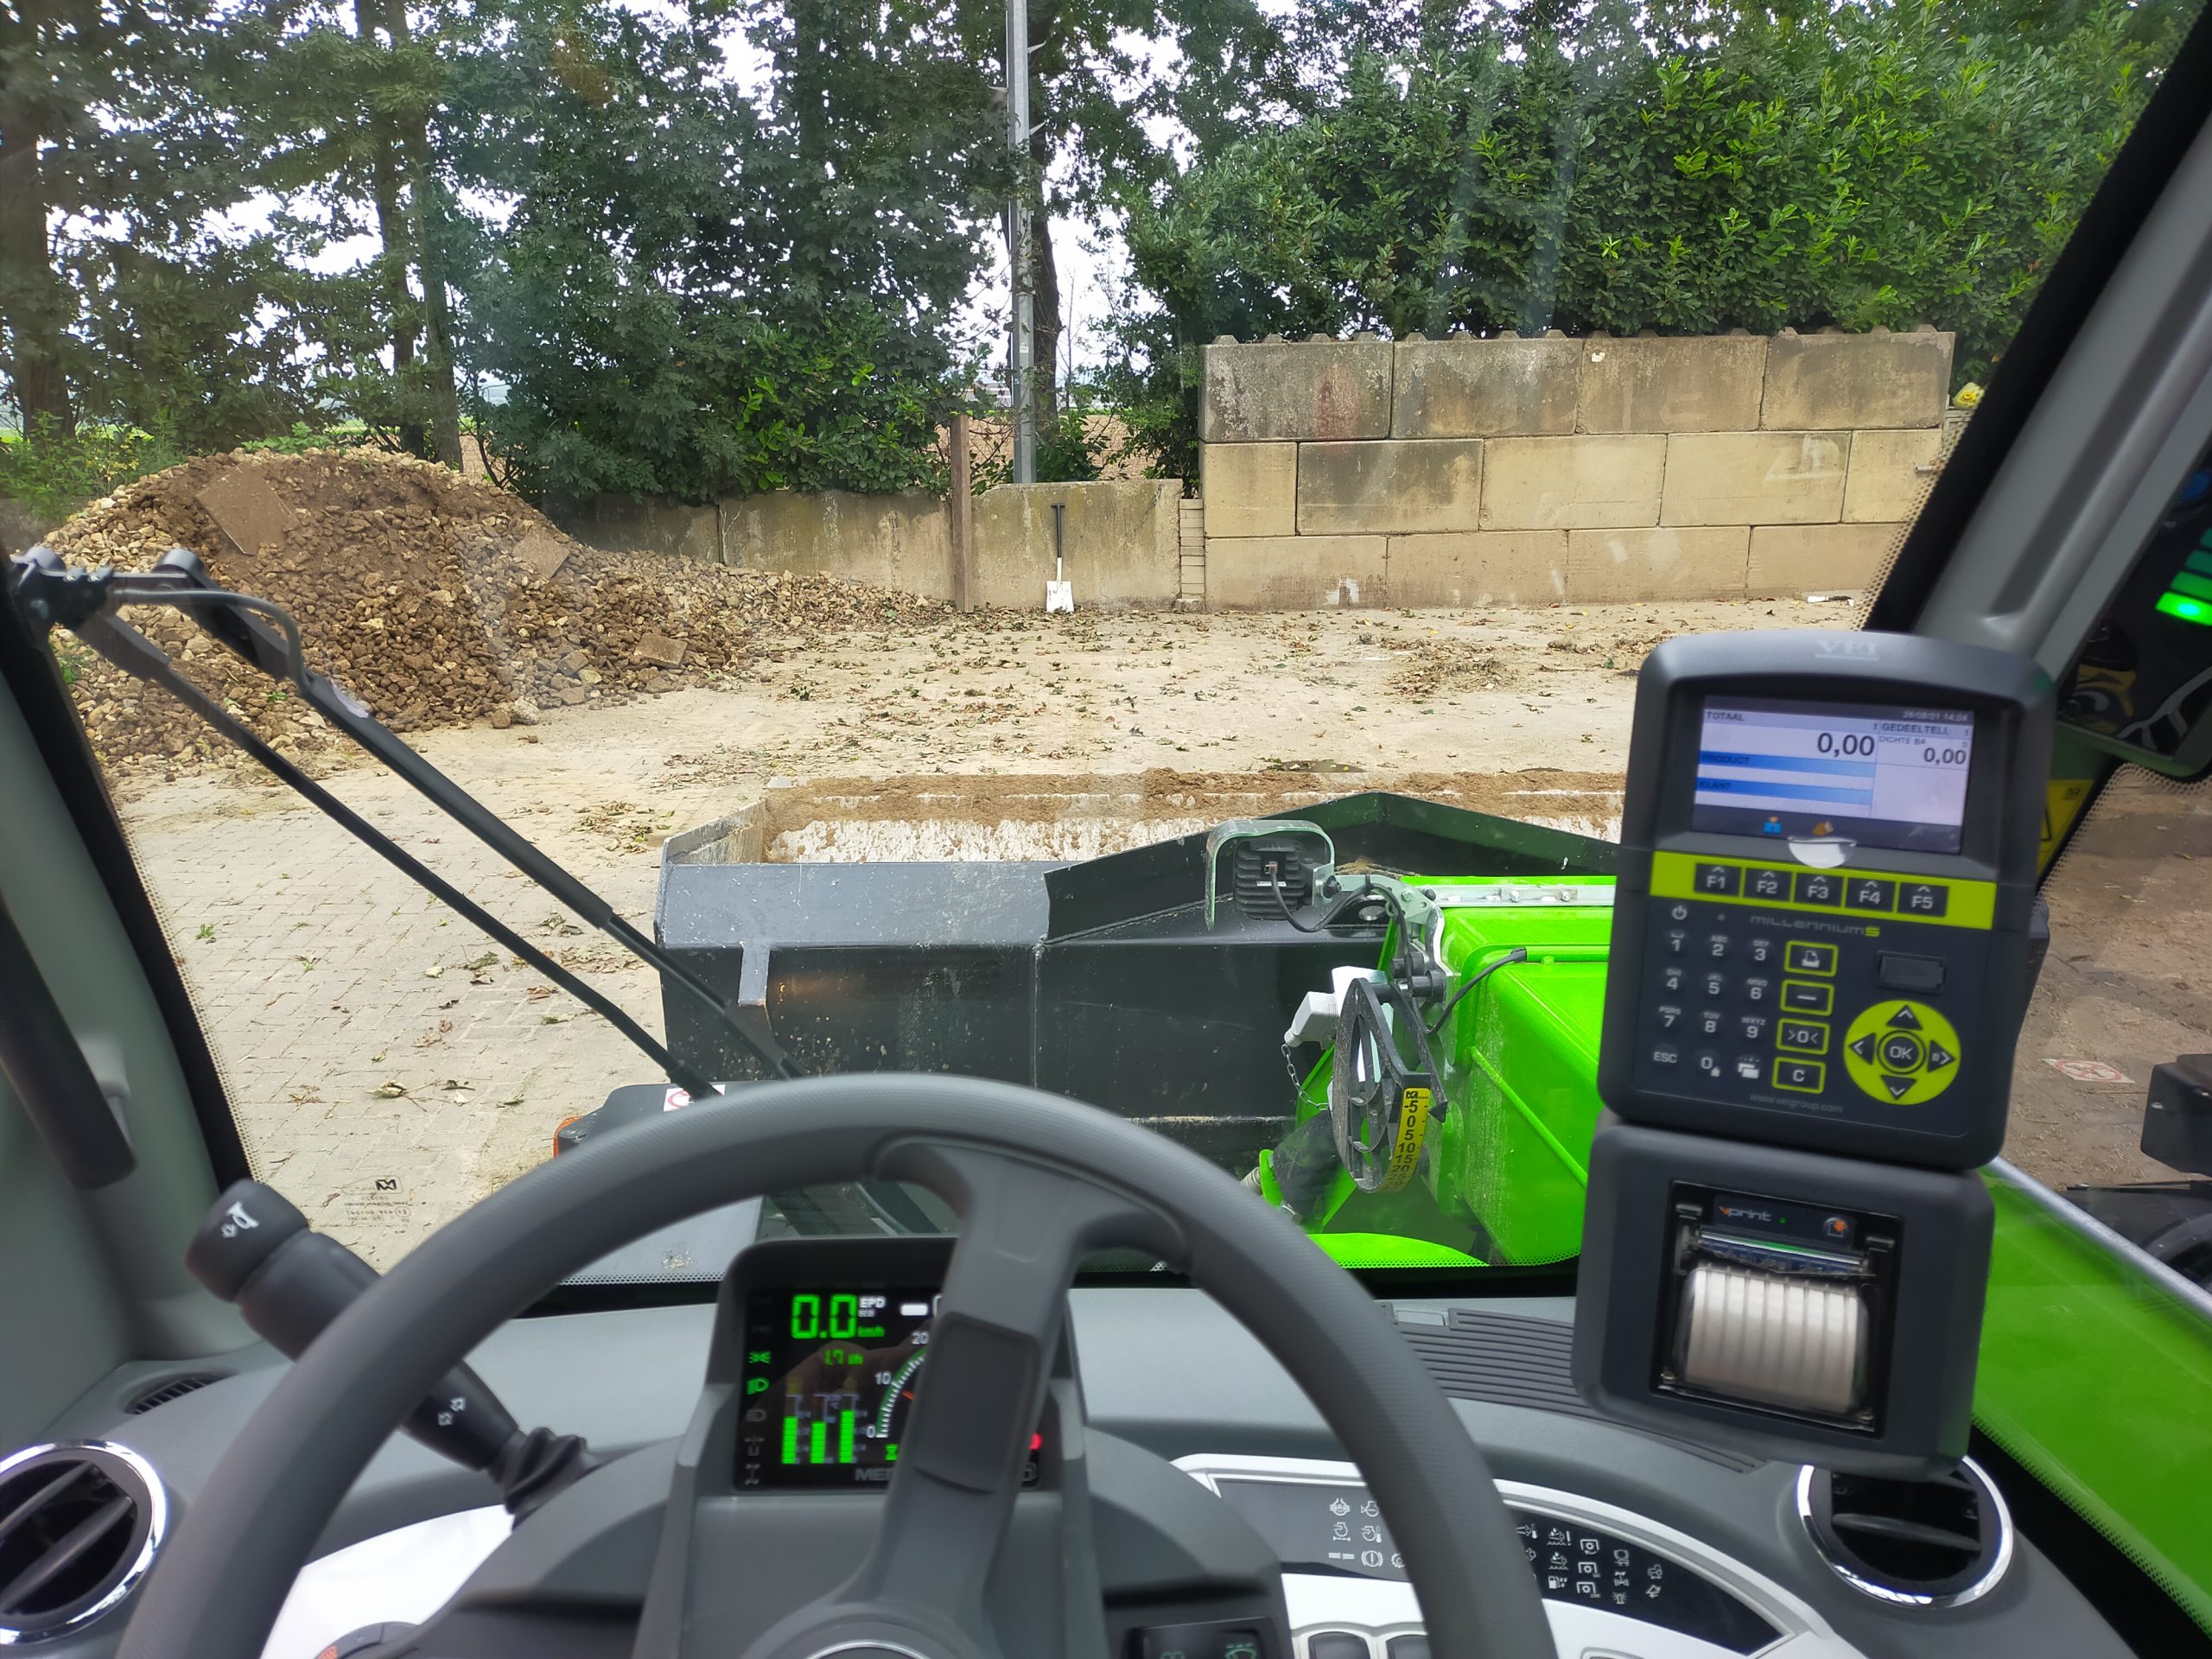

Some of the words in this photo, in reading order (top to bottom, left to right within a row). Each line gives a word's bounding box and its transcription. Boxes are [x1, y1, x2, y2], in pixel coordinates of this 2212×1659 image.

[1707, 711, 1745, 721] TOTAAL
[1817, 732, 1875, 758] 0,00
[1701, 753, 1751, 765] PRODUCT
[1923, 747, 1967, 766] 0,00
[1700, 780, 1732, 790] KLANT
[1706, 875, 1726, 890] F1
[1757, 880, 1778, 894] F2
[1807, 885, 1829, 899] F3
[1859, 890, 1881, 905] F4
[1910, 895, 1934, 910] F5
[1671, 938, 1681, 951] 1
[1712, 944, 1725, 957] 2
[1754, 948, 1766, 961] 3
[1666, 976, 1678, 989] 4
[1708, 982, 1720, 995] 5
[1750, 987, 1762, 1000] 6
[1663, 1014, 1675, 1027] 7
[1704, 1020, 1716, 1033] 8
[1746, 1026, 1758, 1039] 9
[1653, 1051, 1678, 1064] ESC
[1889, 1046, 1914, 1060] OK
[1700, 1057, 1713, 1070] 0
[1792, 1069, 1806, 1083] C
[1407, 1116, 1416, 1128] 0
[1404, 1129, 1414, 1141] 5
[1398, 1142, 1416, 1154] 10
[1395, 1154, 1414, 1164] 15
[791, 1294, 857, 1338] 0.0
[912, 1331, 929, 1344] 20
[874, 1370, 892, 1385] 10
[866, 1424, 876, 1438] 0
